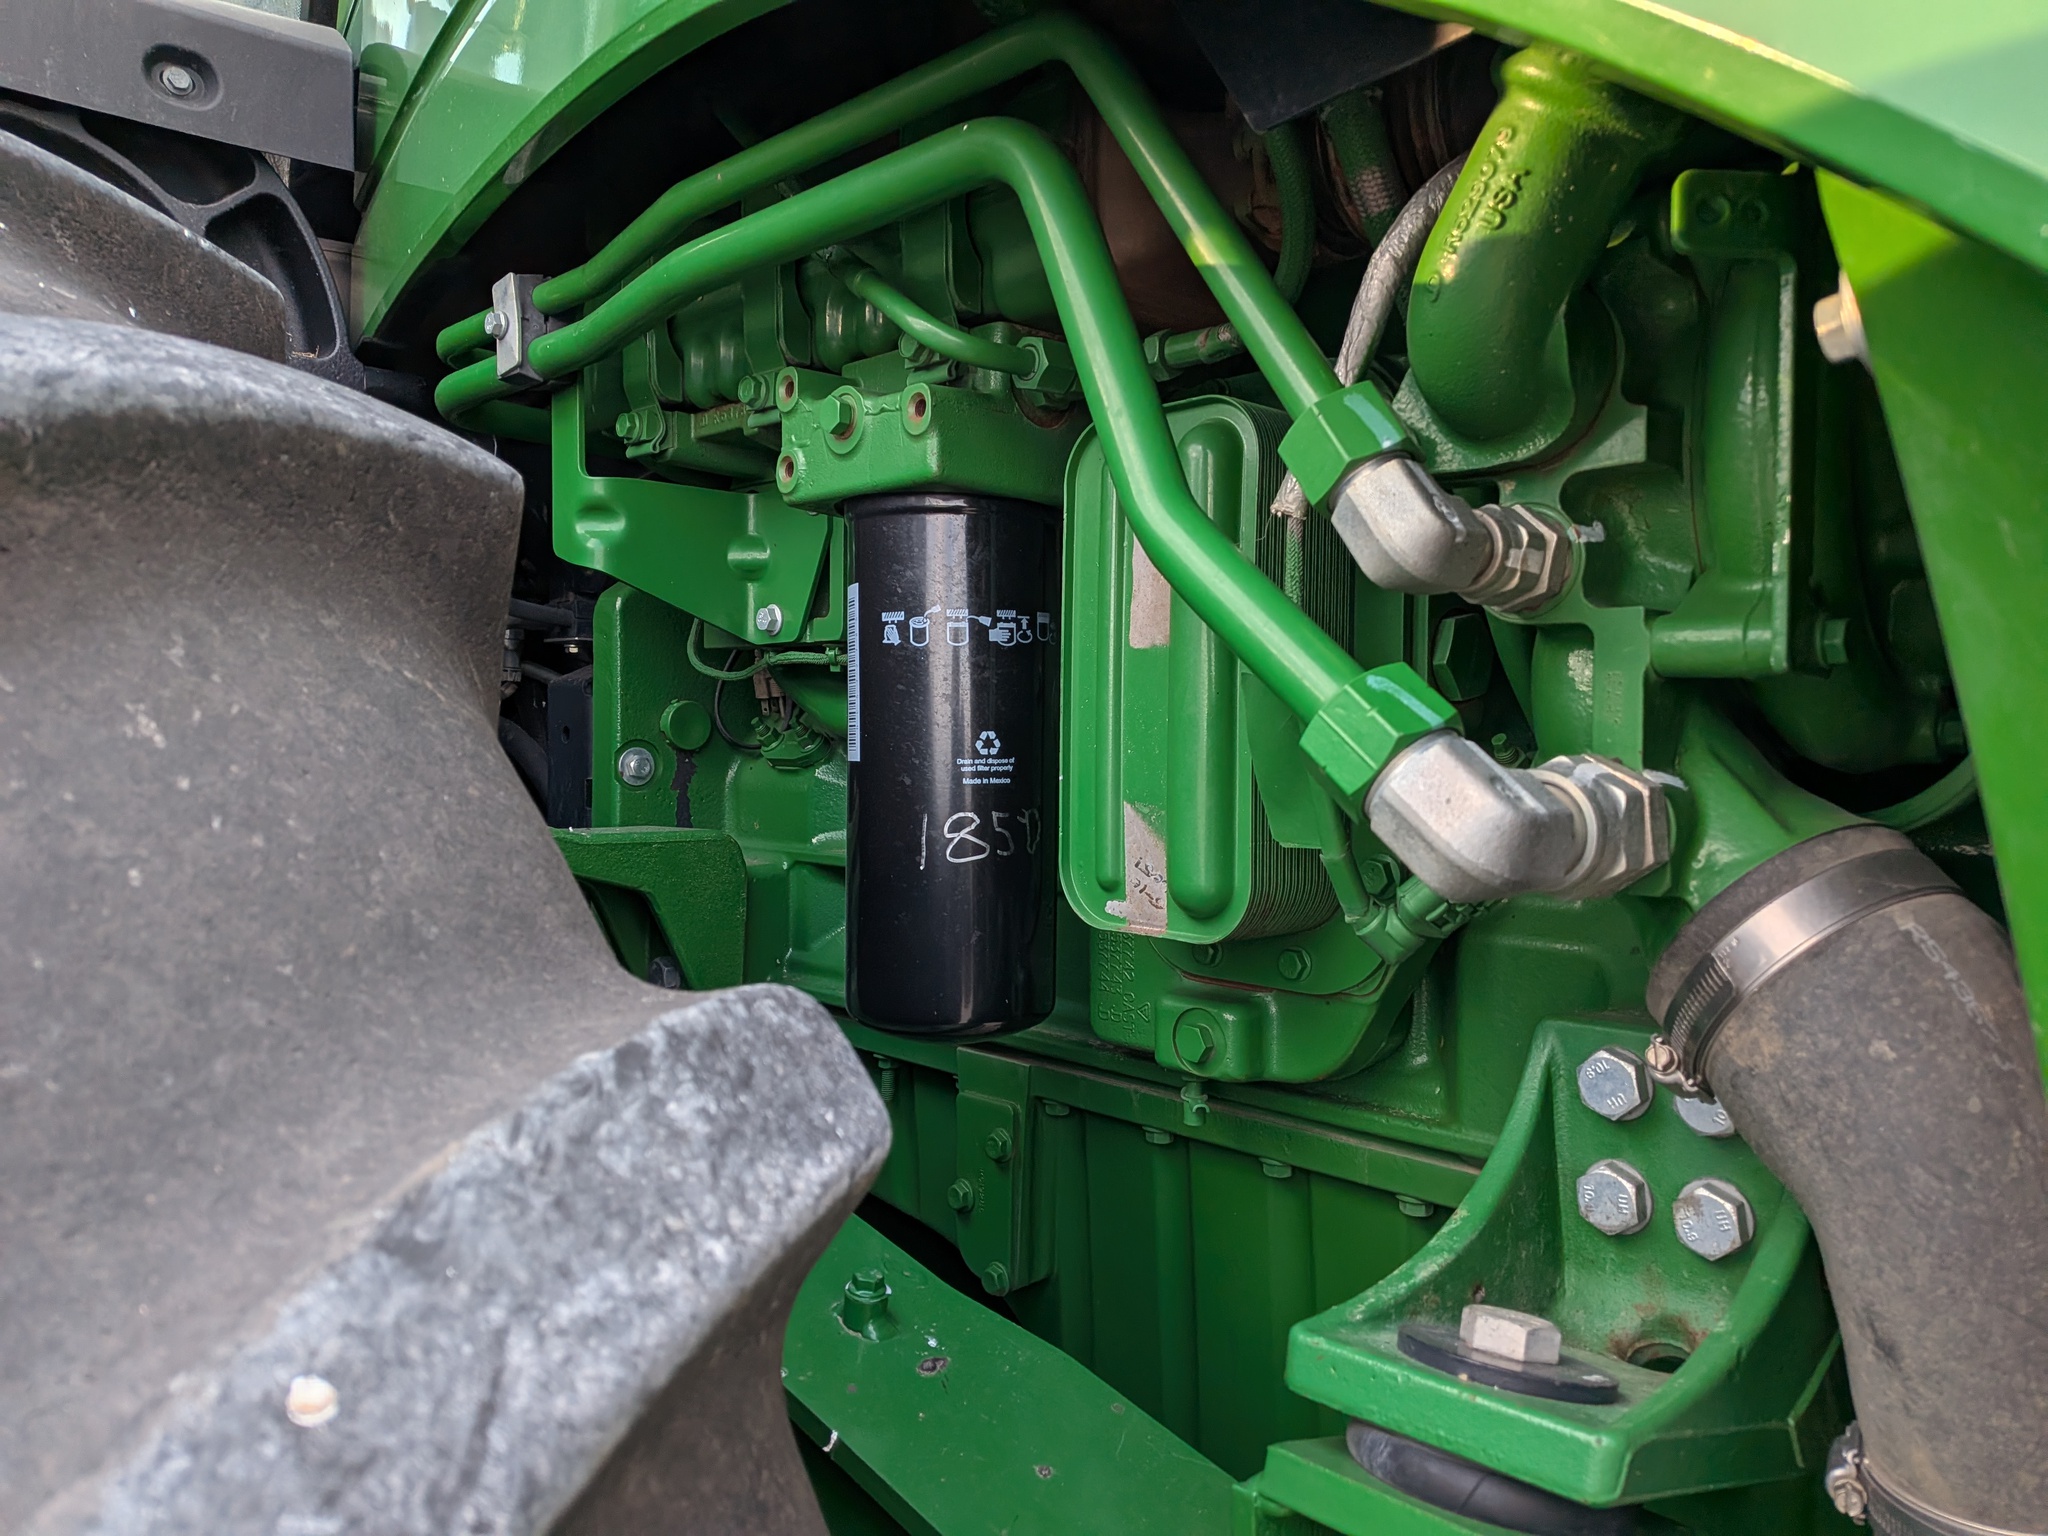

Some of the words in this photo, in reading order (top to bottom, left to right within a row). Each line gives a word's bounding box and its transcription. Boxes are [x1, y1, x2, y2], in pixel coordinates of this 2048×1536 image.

[1477, 168, 1532, 231] USA
[986, 757, 1008, 765] dispose
[1009, 756, 1015, 764] of
[990, 764, 1014, 773] properly
[962, 777, 981, 785] Made
[989, 776, 1011, 784] Mexico
[1585, 1059, 1611, 1080] 10.9
